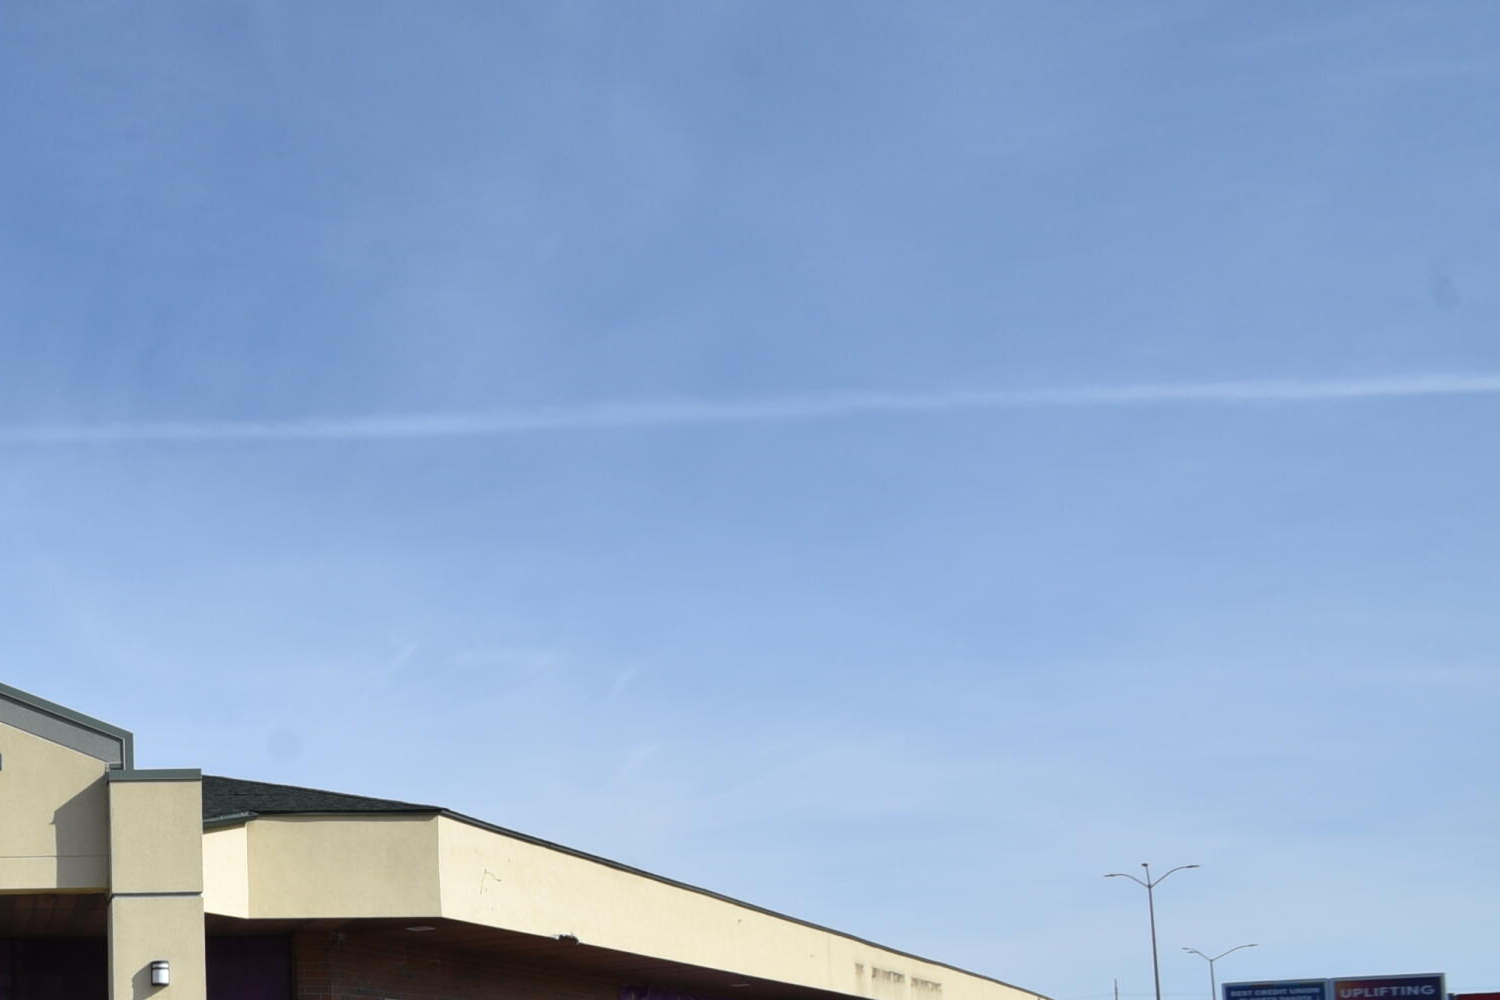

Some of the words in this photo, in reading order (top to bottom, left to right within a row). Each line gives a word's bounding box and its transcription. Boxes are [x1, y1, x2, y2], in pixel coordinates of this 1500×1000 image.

[1255, 988, 1288, 997] CREDIT
[1289, 987, 1321, 995] UNION
[1340, 984, 1436, 999] UPLIFTING
